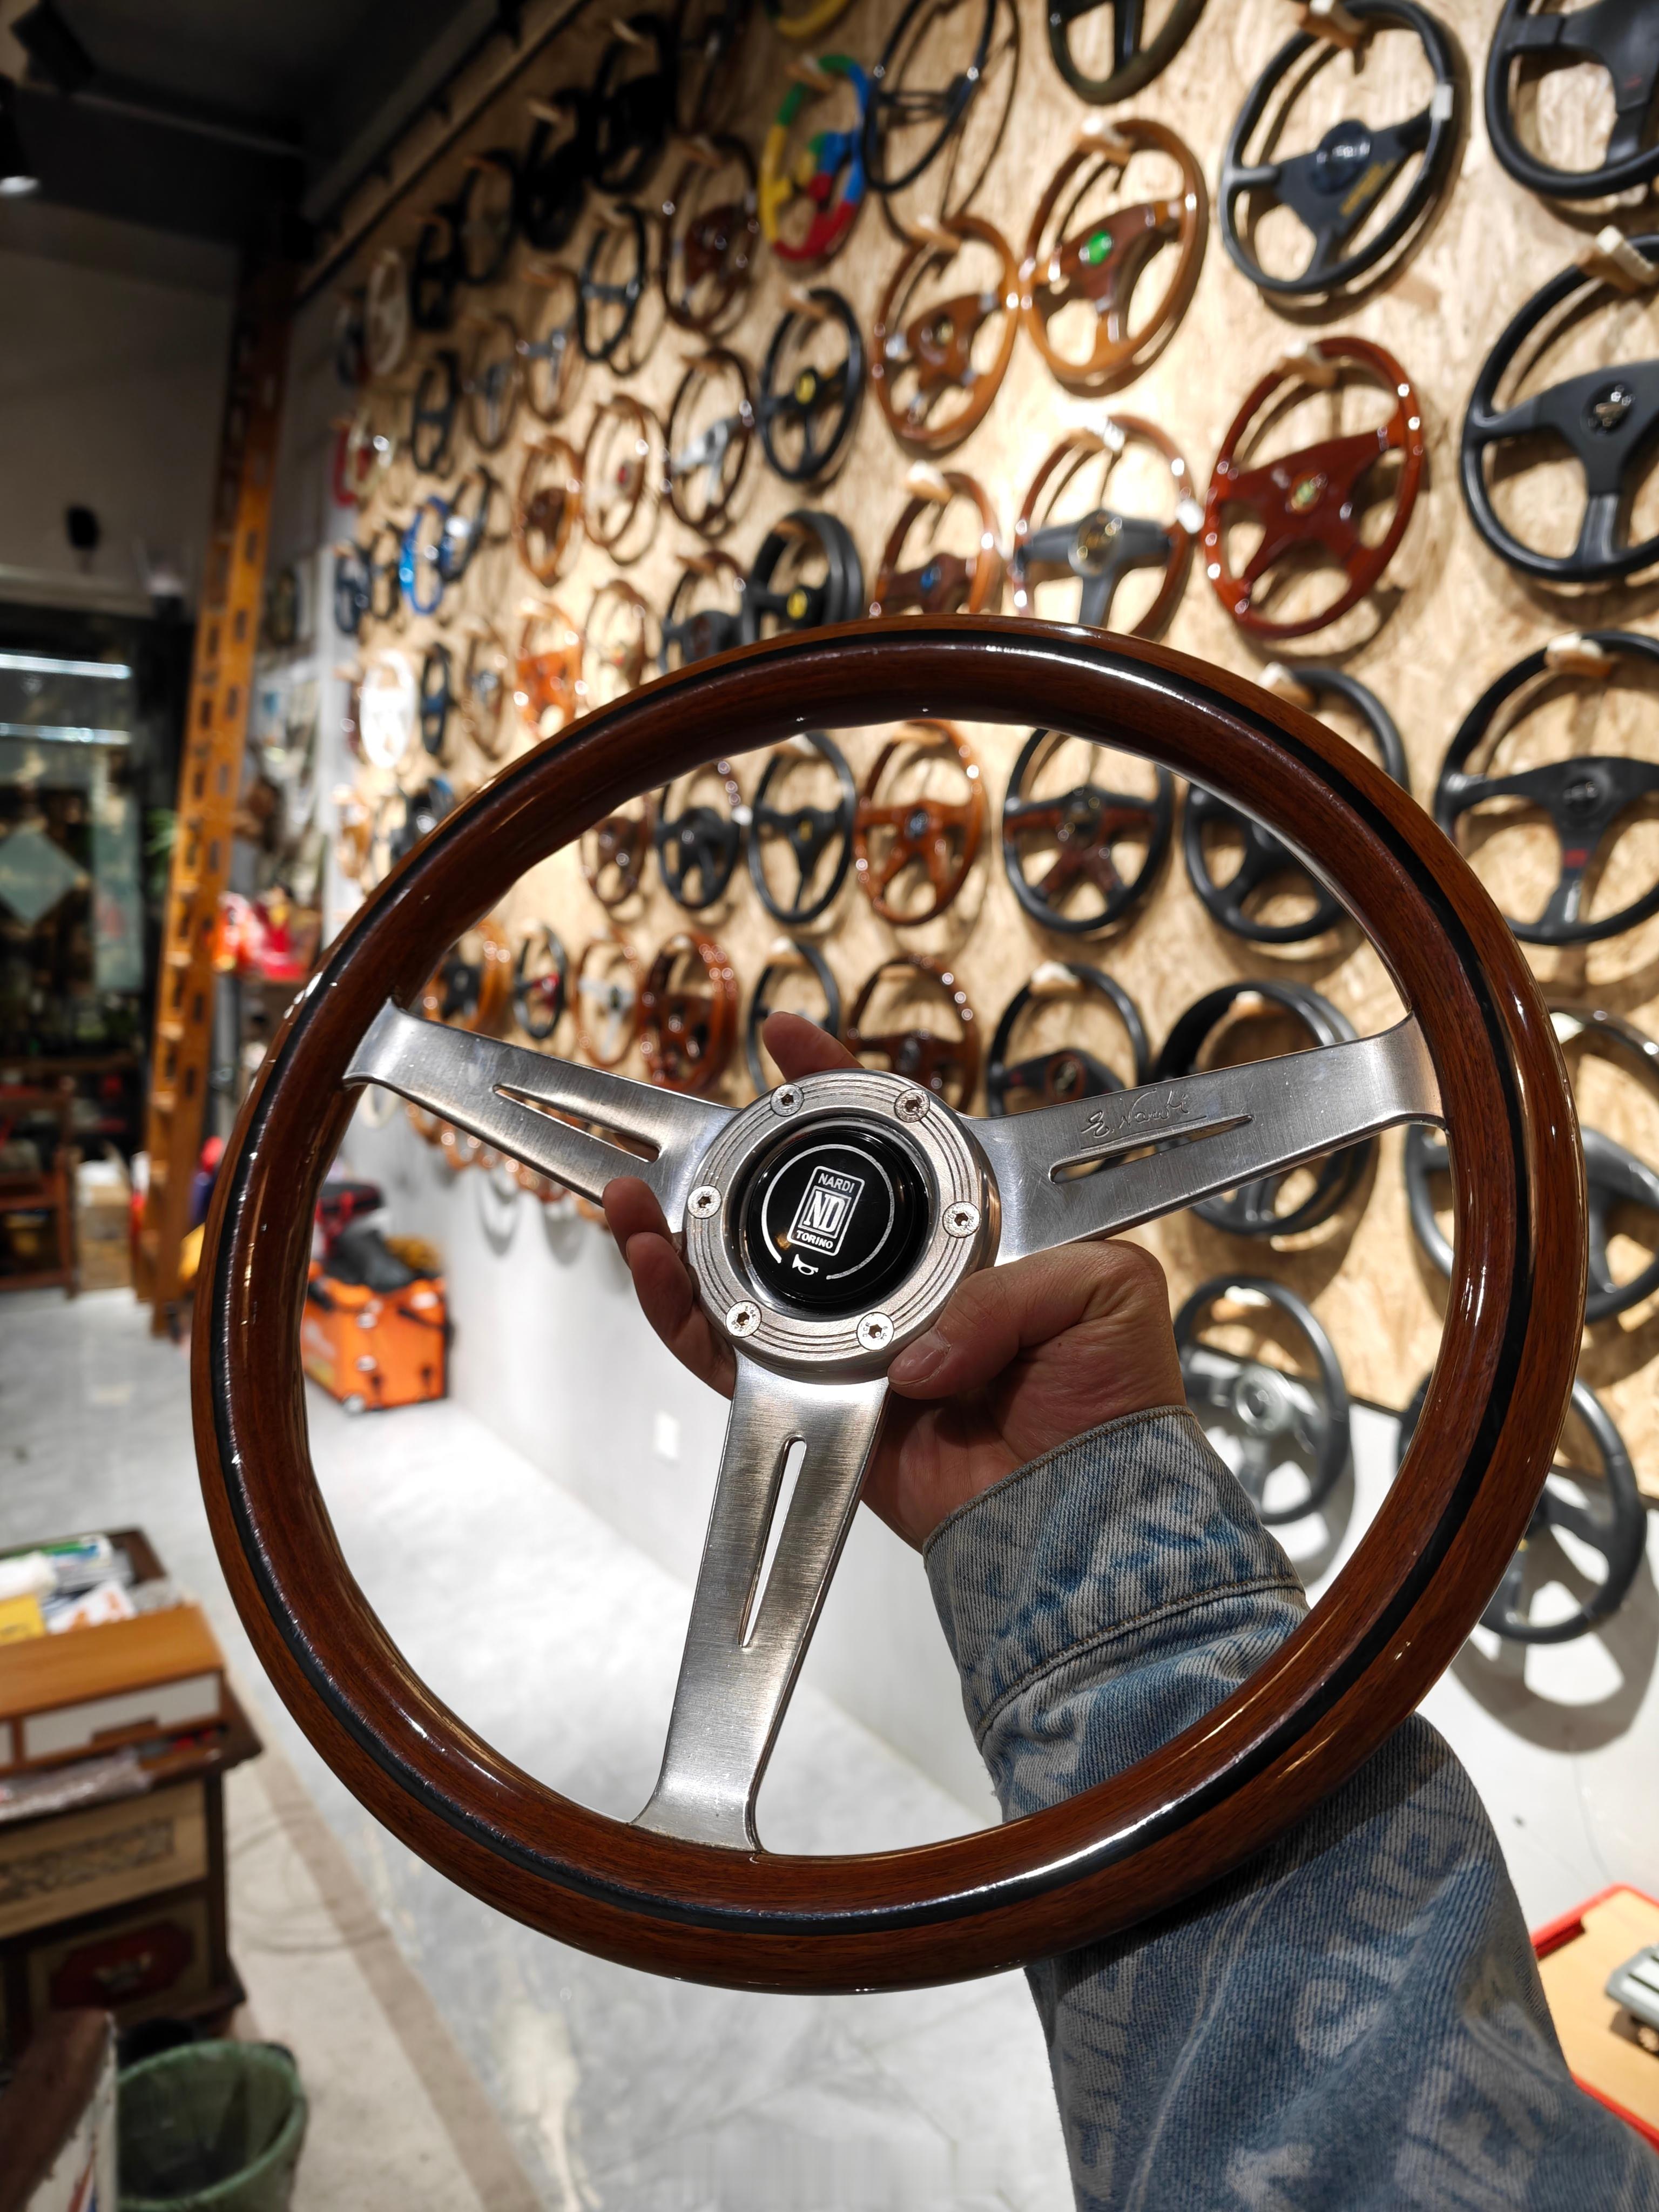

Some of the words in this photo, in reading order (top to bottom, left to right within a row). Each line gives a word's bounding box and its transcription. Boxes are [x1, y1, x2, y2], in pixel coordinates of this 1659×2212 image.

[818, 1172, 855, 1193] NARDI
[803, 1190, 846, 1232] ND
[795, 1229, 834, 1250] TORINO
